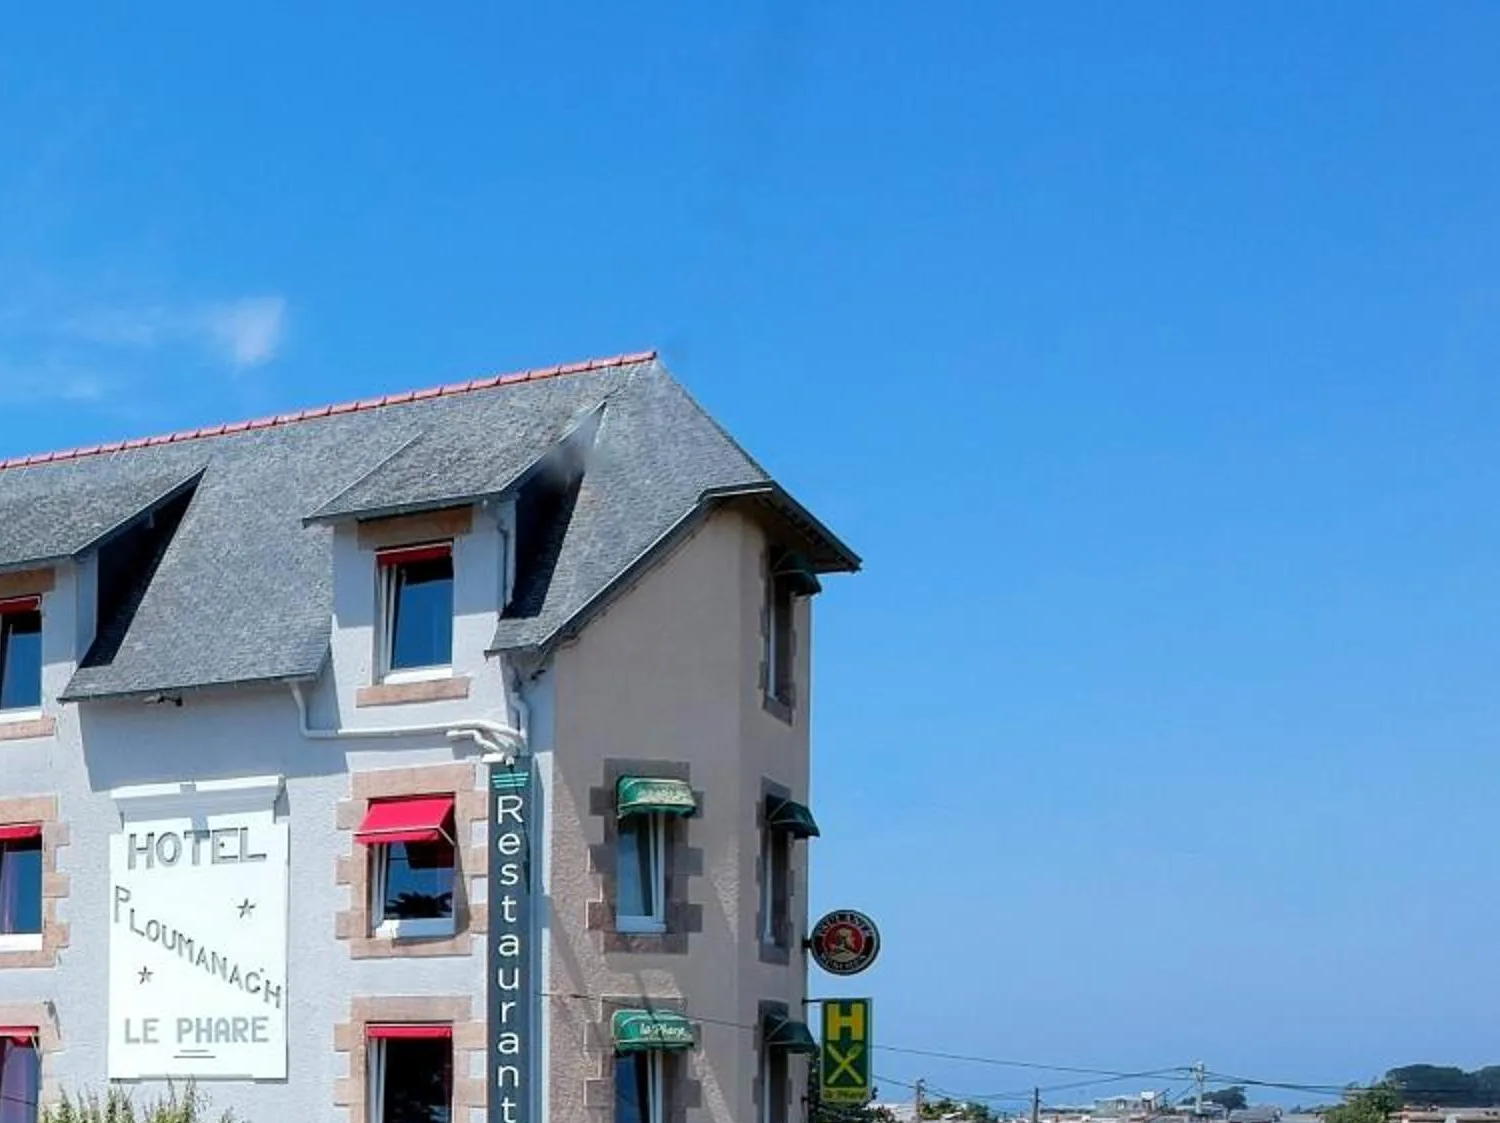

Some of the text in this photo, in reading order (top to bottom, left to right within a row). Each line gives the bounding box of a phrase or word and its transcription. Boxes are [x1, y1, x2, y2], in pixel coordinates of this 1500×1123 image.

[127, 827, 268, 870] HOTEL
[124, 1016, 270, 1044] LE PHARE
